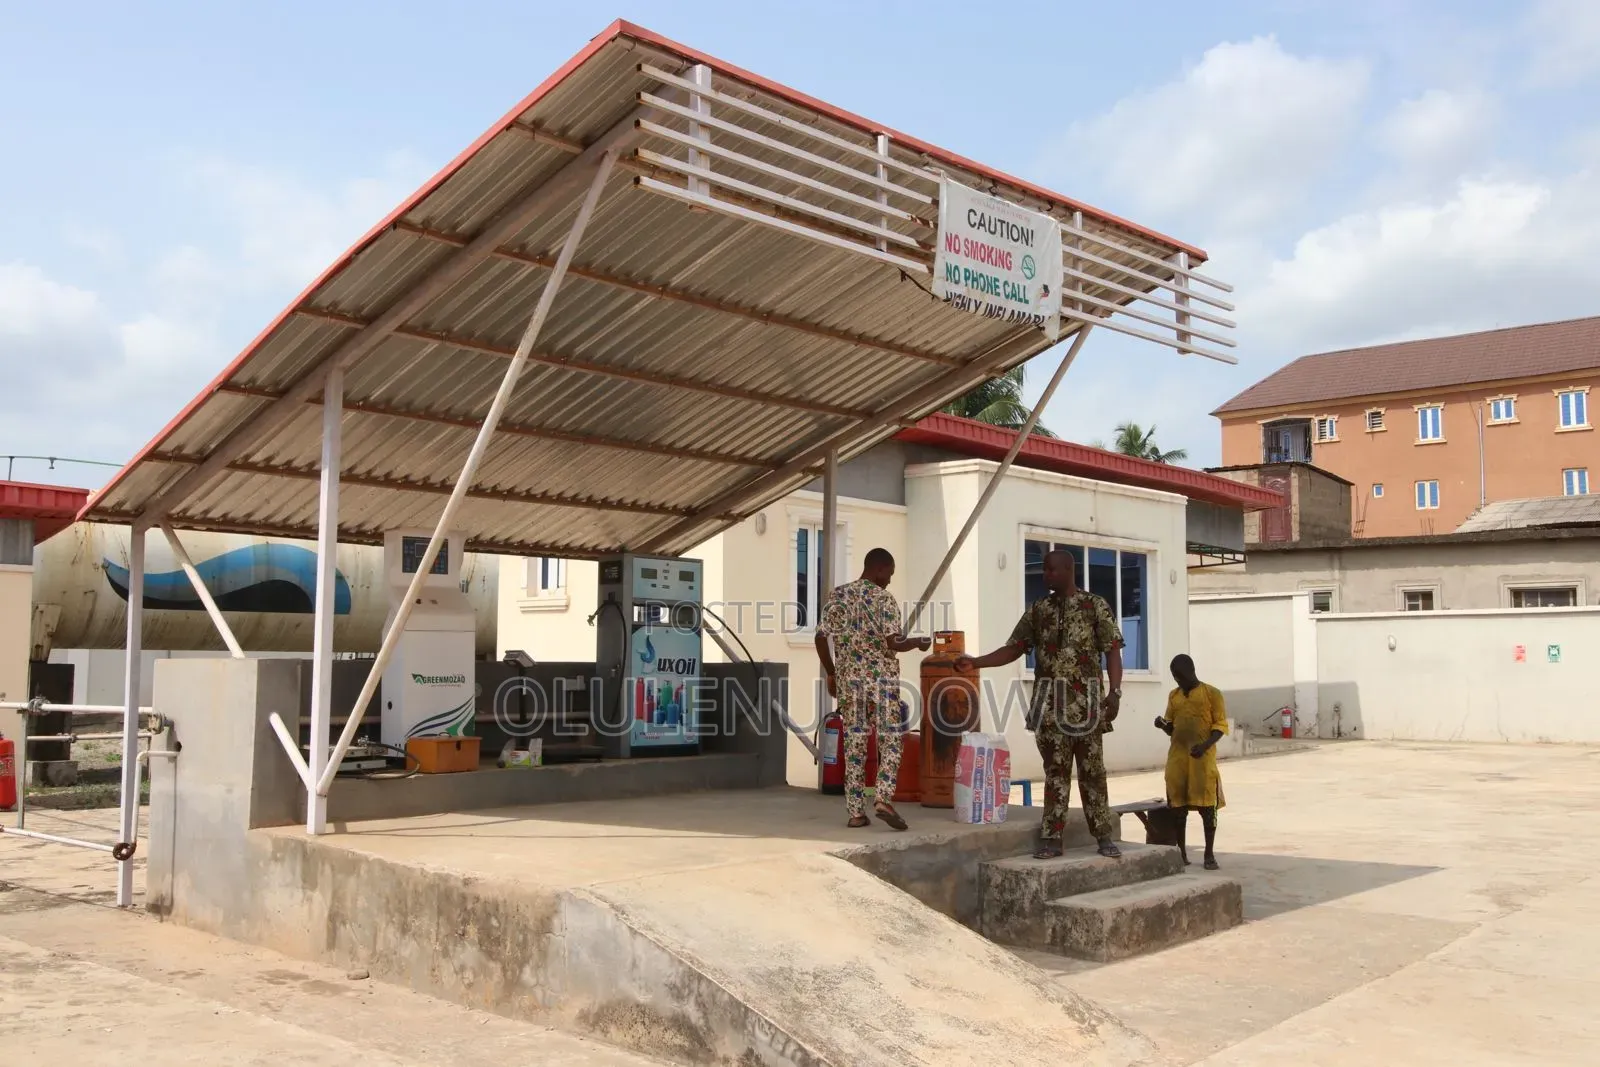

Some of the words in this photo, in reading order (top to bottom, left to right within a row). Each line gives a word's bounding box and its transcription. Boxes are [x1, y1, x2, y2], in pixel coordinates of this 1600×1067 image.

[967, 208, 1034, 247] CAUTION!
[944, 232, 961, 255] NO
[964, 238, 1013, 271] SMOKING
[945, 262, 961, 285] NO
[964, 271, 1000, 297] PHONE
[1002, 280, 1030, 304] CALL
